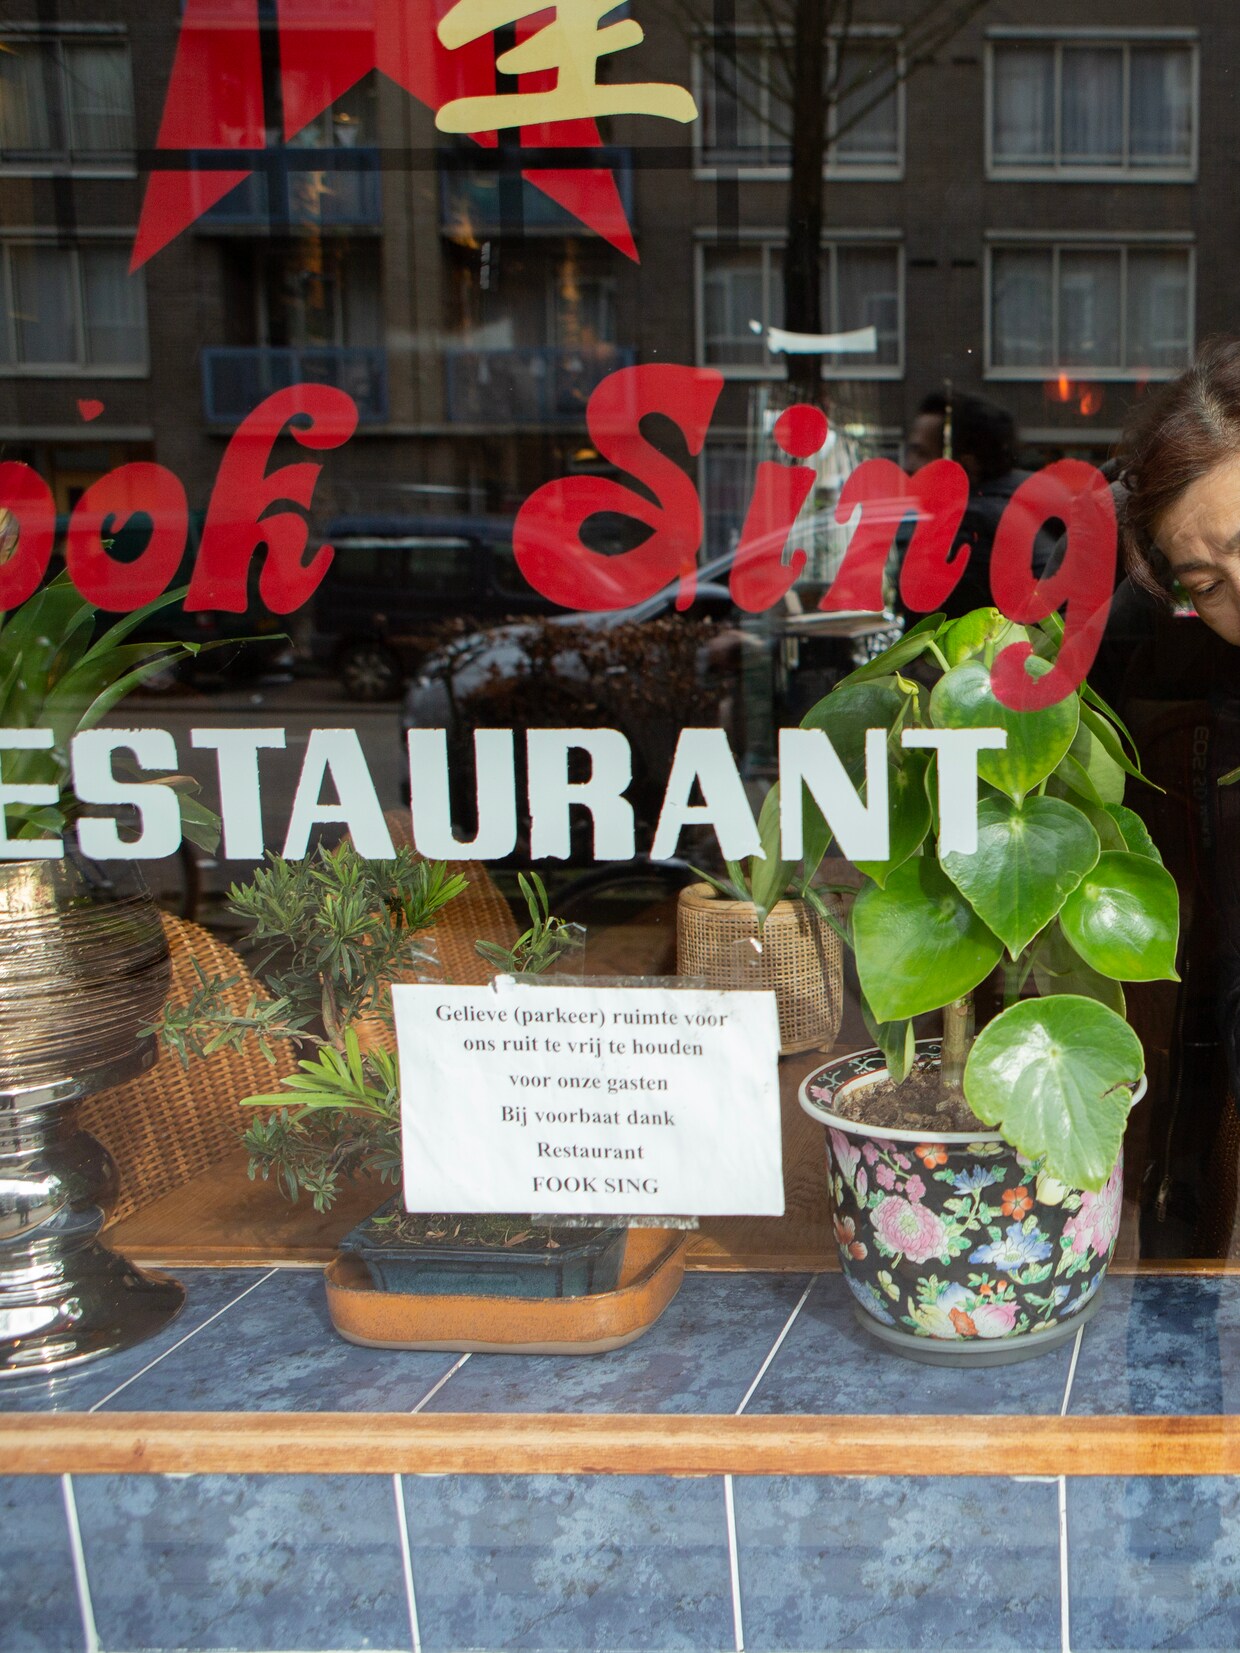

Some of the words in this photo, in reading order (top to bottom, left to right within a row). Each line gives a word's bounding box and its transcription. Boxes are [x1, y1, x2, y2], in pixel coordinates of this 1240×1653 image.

[513, 363, 1118, 713] Sing
[435, 1004, 508, 1023] Gelieve
[513, 1006, 606, 1028] (parkeer)
[613, 1008, 679, 1026] ruimte
[684, 1011, 729, 1028] voor
[463, 1038, 496, 1052] ons
[502, 1036, 538, 1052] ruit
[544, 1038, 561, 1053] te
[567, 1037, 601, 1059] vrij
[608, 1040, 626, 1055] te
[632, 1038, 703, 1056] houden
[509, 1074, 552, 1088] voor
[557, 1076, 601, 1090] onze
[607, 1075, 669, 1094] gasten
[501, 1105, 528, 1127] Bij
[535, 1107, 620, 1126] voorbaat
[626, 1108, 676, 1127] dank
[536, 1141, 645, 1161] Restaurant
[533, 1176, 598, 1194] FOOK
[604, 1178, 659, 1195] SING
